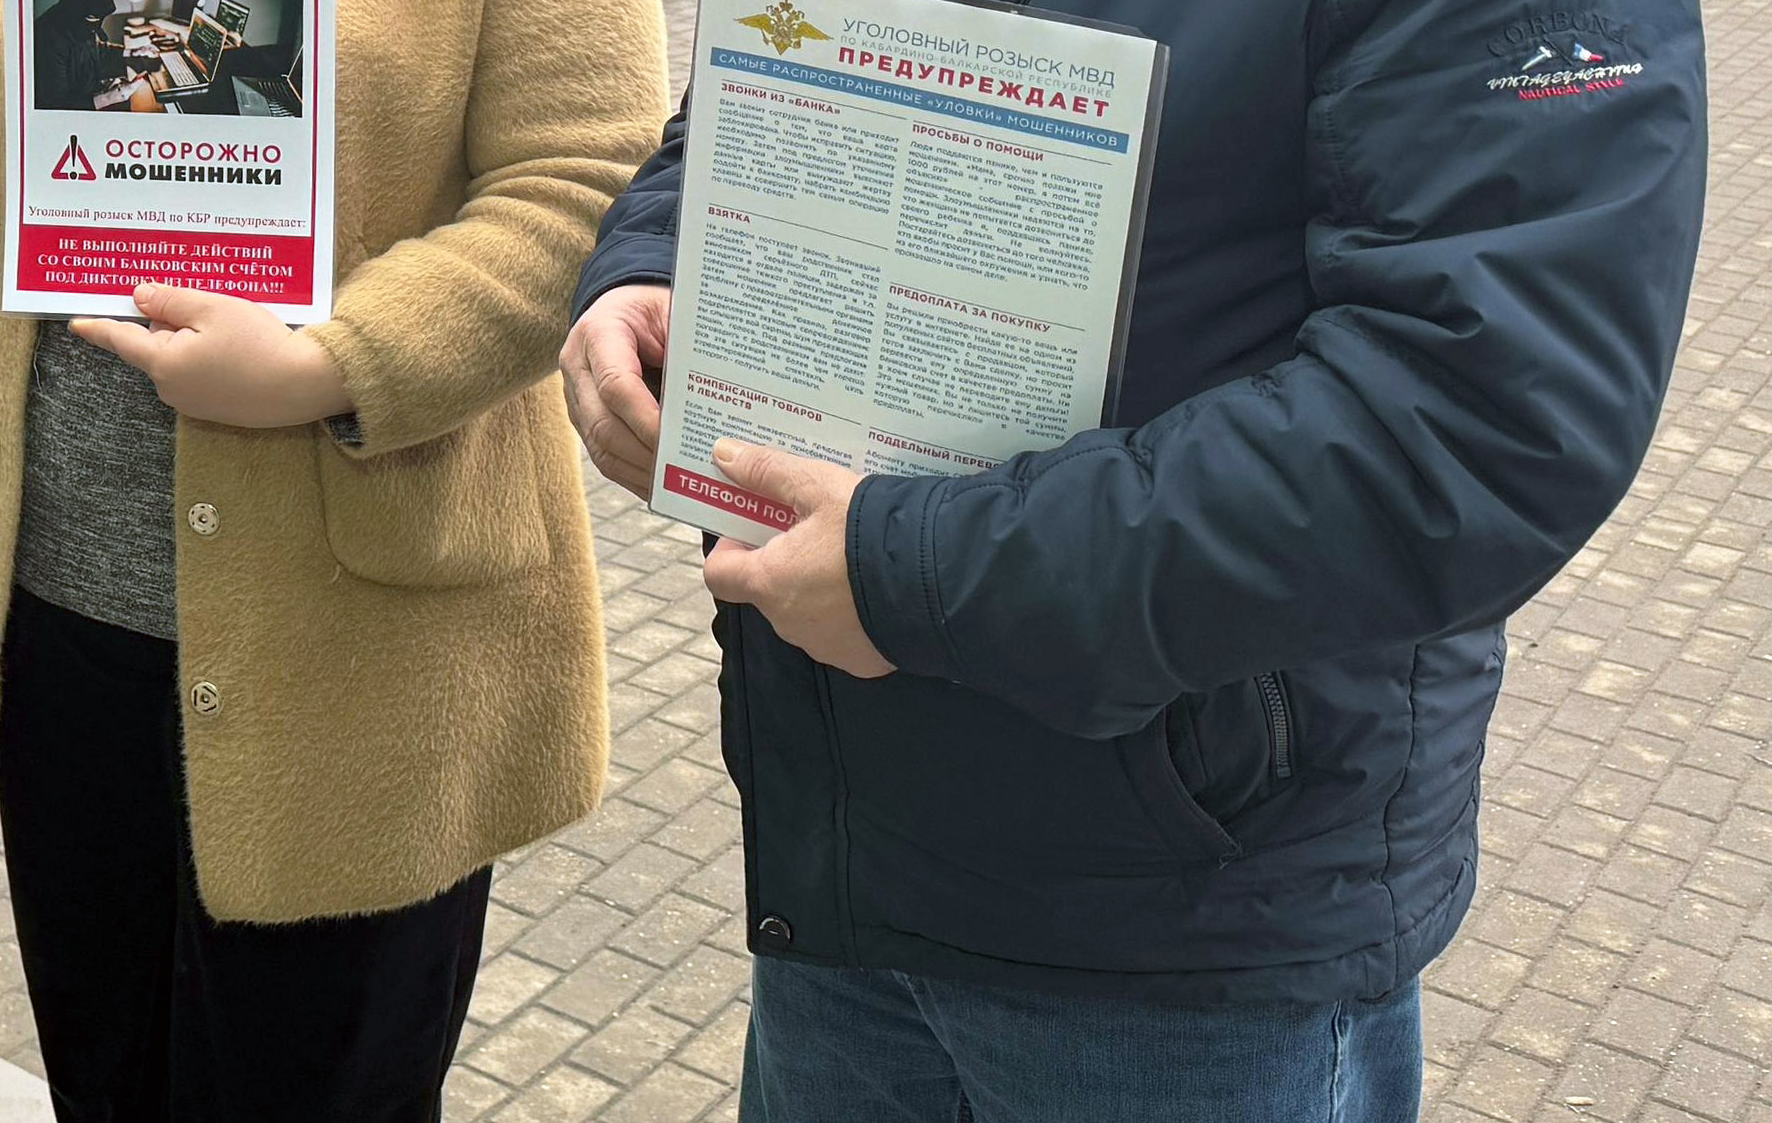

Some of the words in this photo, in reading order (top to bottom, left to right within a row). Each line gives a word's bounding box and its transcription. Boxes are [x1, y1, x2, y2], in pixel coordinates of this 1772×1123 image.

[840, 35, 856, 45] ПО
[841, 17, 969, 58] УГОЛОВНЫЙ
[975, 44, 1063, 76] РОЗЫСК
[1068, 62, 1116, 88] МВД
[837, 46, 1110, 119] ПРЕДУПРЕЖДАЕТ
[718, 53, 767, 72] САМЫЕ
[772, 63, 922, 105] РАСПРОСТРАНЕННЫЕ
[927, 96, 1002, 123] «УЛОВКИ»
[1007, 114, 1118, 147] МОШЕННИКОВ
[721, 82, 767, 99] ЗВОНКИ
[770, 93, 784, 103] ИЗ
[788, 96, 841, 115] «БАНКА»
[105, 139, 281, 163] ОСТОРОЖНО
[912, 124, 969, 144] ПРОСЬБЫ
[973, 138, 982, 147] О
[985, 141, 1044, 162] ПОМОЩИ
[105, 163, 281, 185] МОШЕННИКИ
[29, 206, 90, 219] Уголовный
[93, 210, 132, 222] розыск
[137, 211, 165, 223] МВД
[170, 215, 182, 223] по
[187, 213, 210, 223] КБР
[214, 216, 305, 230] предупреждает:
[708, 205, 750, 224] ВЗЯТКА
[59, 238, 77, 250] НЕ
[82, 237, 186, 255] ВЫПОЛНЯЙТЕ
[191, 242, 272, 261] ДЕЙСТВИЙ
[37, 254, 57, 264] СО
[62, 255, 115, 268] СВОИМ
[120, 258, 224, 274] БАНКОВСКИМ
[229, 262, 292, 277] СЧЁТОМ
[46, 271, 76, 284] ПОД
[81, 273, 157, 287] ДИКТОВКУ
[185, 278, 283, 293] ТЕЛЕФОНА!!!
[888, 285, 968, 314] ПРЕДОПЛАТА
[971, 307, 987, 318] ЗА
[991, 311, 1050, 334] ПОКУПКУ
[686, 384, 694, 392] И
[697, 387, 752, 409] ЛЕКАРСТВ
[687, 373, 768, 404] КОМПЕНСАЦИЯ
[770, 399, 822, 422] ТОВАРОВ
[867, 431, 950, 460] ПОДДЕЛЬНЫЙ
[677, 474, 759, 512] ТЕЛЕФОН
